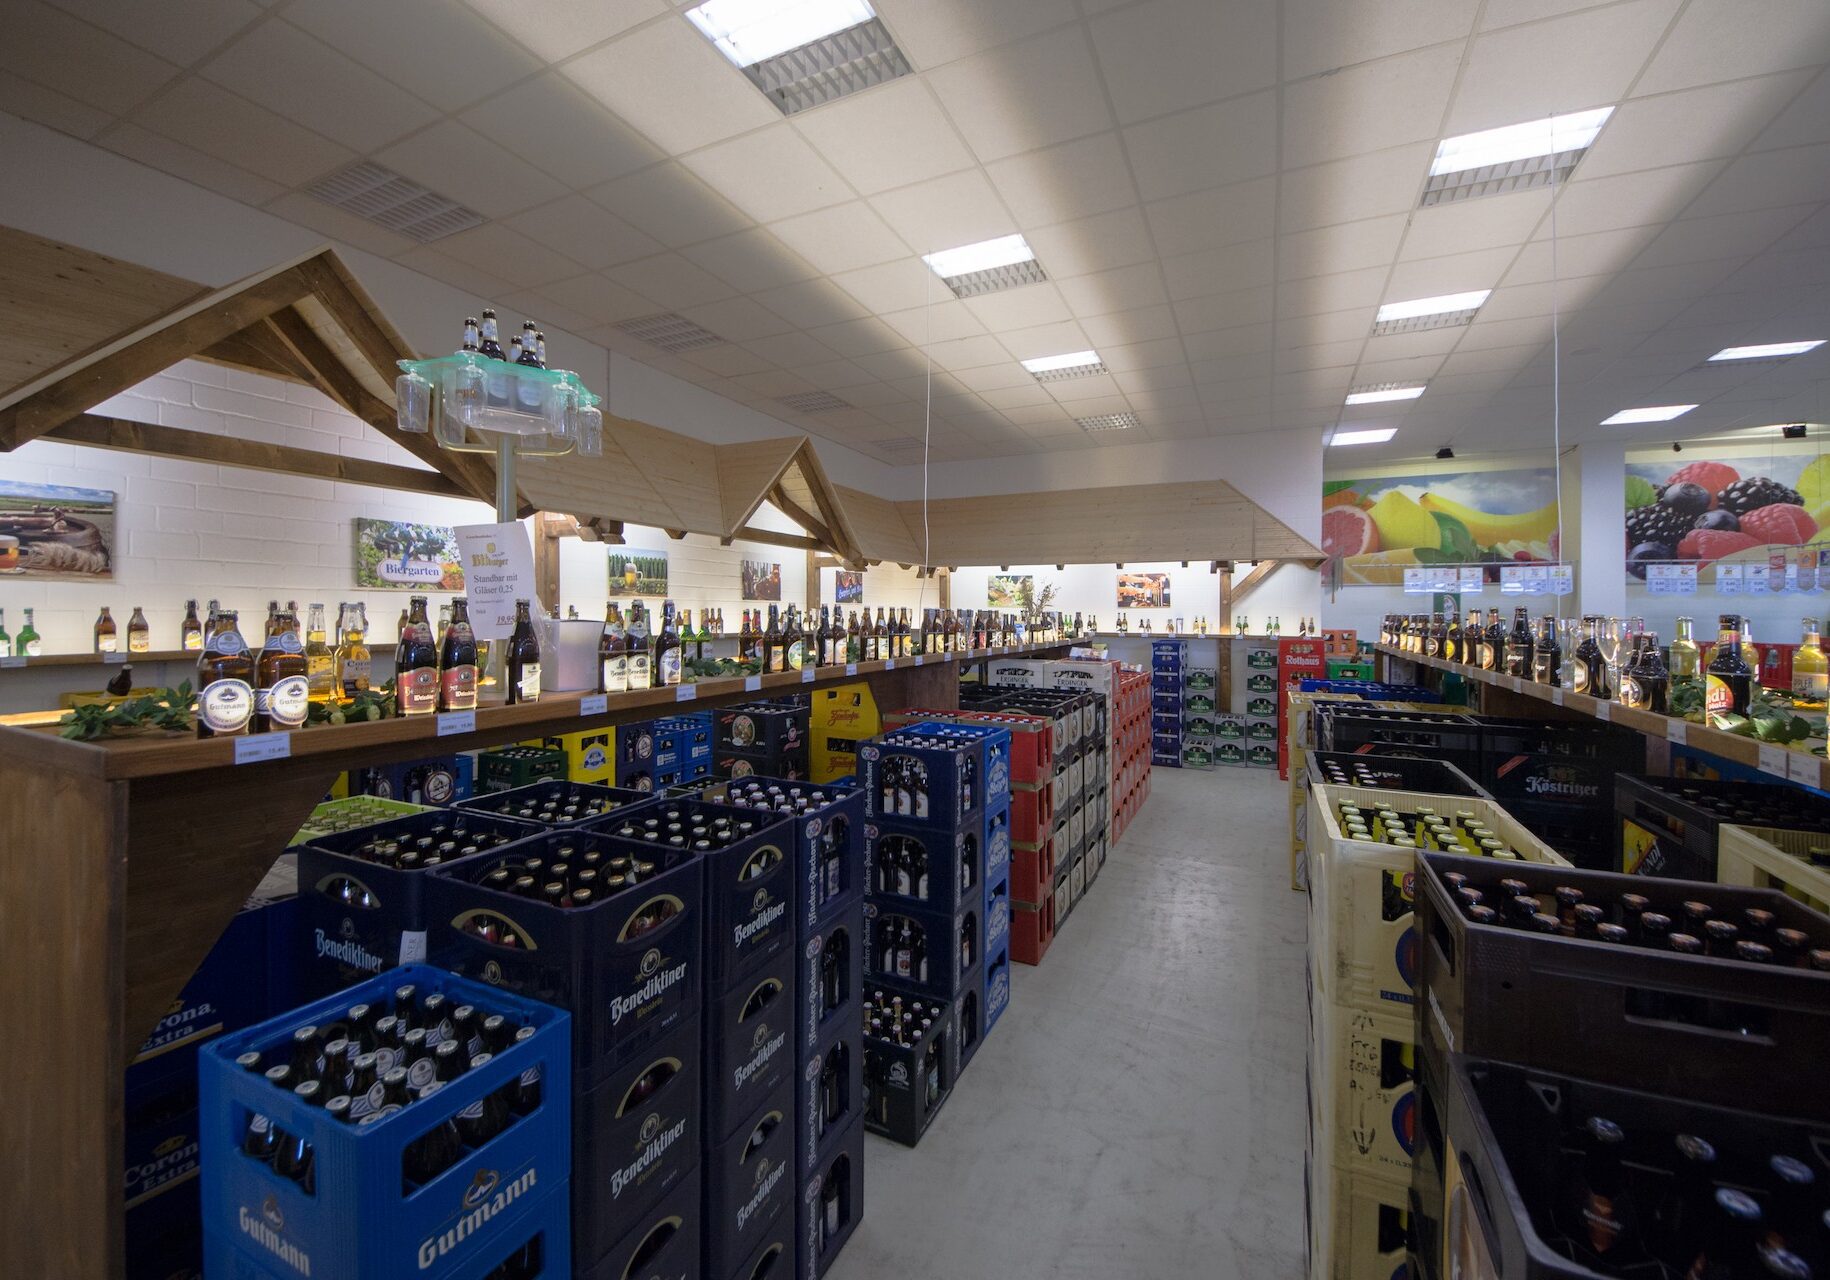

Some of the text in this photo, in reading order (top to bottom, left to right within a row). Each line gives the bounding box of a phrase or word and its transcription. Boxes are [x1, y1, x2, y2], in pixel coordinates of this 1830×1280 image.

[386, 563, 439, 576] Biergarten
[473, 573, 518, 583] Standbar mit
[475, 585, 514, 595] Gläser 0,25
[1285, 654, 1320, 666] Rothaus
[734, 901, 786, 948] Benediktiner
[315, 928, 383, 974] Benediktiner
[610, 961, 687, 1026] Benediktiner
[734, 1032, 786, 1091] Benediktiner
[123, 1142, 199, 1188] Coron
[610, 1118, 687, 1201] Benediktiner
[417, 1166, 538, 1271] Gutmann
[736, 1160, 786, 1231] Benediktiner
[239, 1205, 311, 1277] Gutmann
